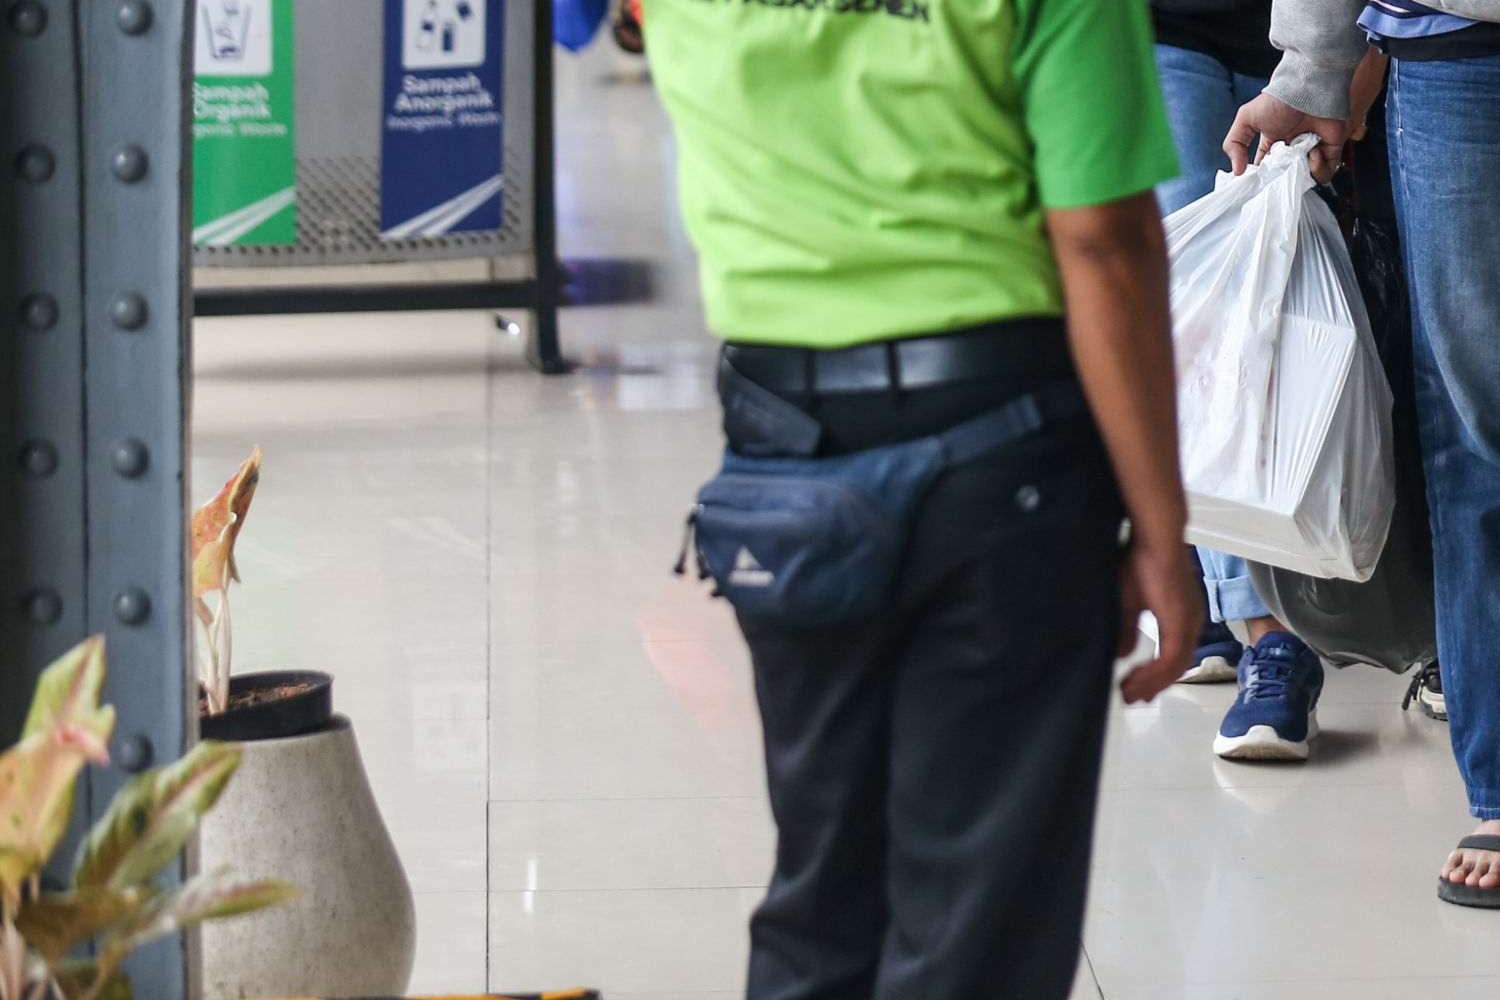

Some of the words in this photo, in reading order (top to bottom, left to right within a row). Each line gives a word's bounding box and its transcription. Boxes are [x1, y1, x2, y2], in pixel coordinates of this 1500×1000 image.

[402, 73, 481, 94] Sampah
[194, 98, 272, 123] Organik
[393, 90, 494, 115] Anorganik
